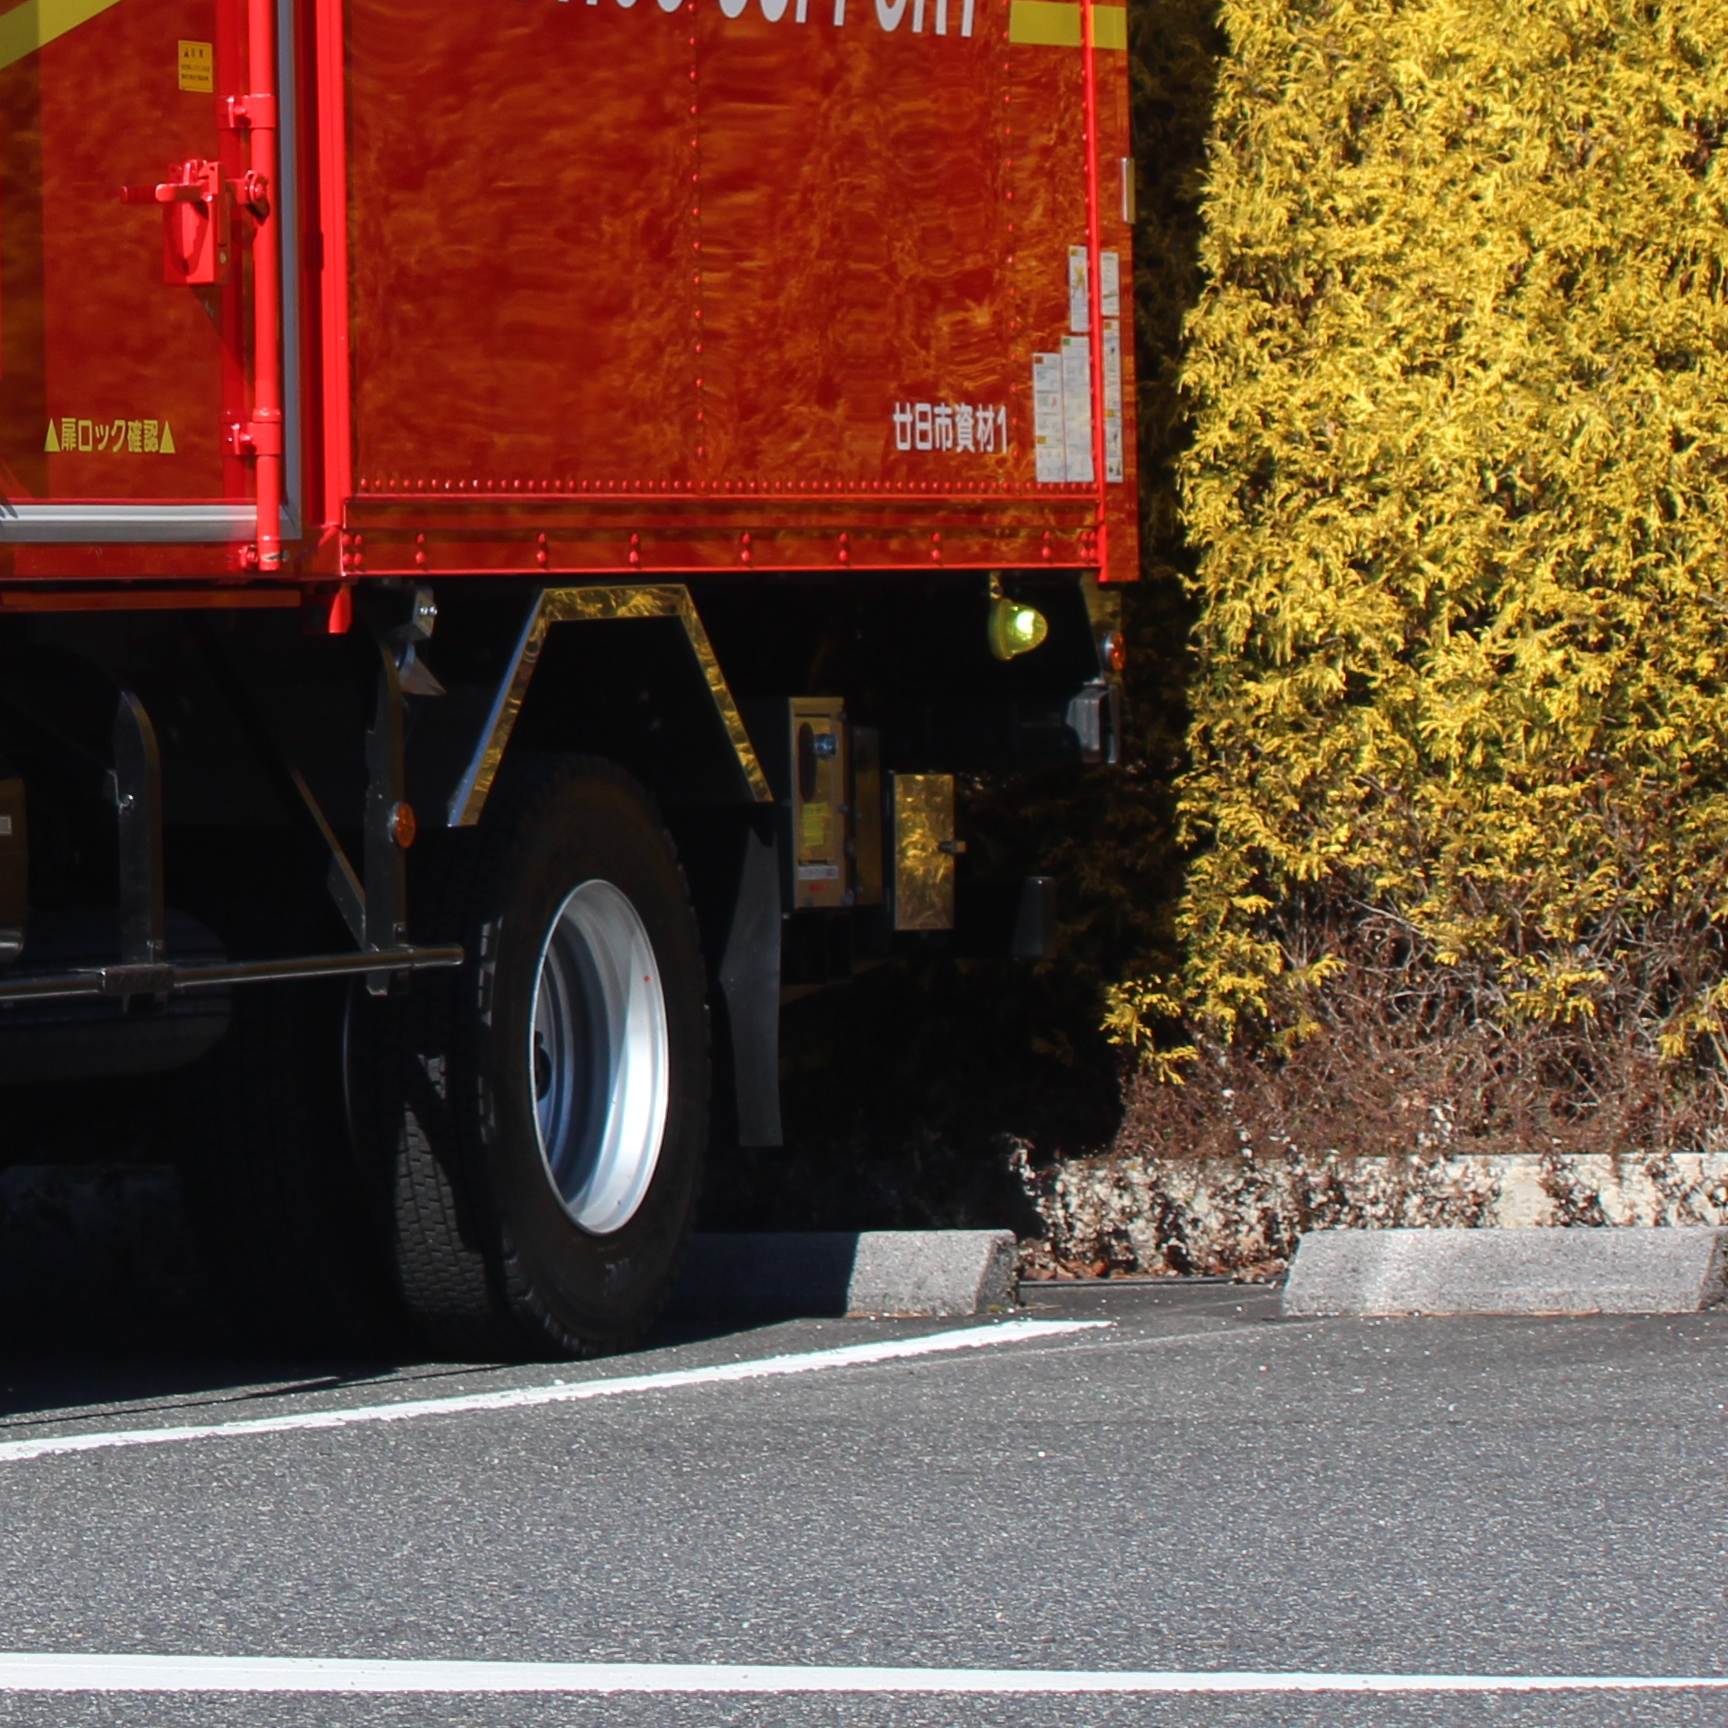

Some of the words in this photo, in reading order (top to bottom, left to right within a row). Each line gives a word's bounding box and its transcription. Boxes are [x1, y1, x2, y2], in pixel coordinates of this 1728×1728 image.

[893, 402, 1007, 454] 廿日市資材1
